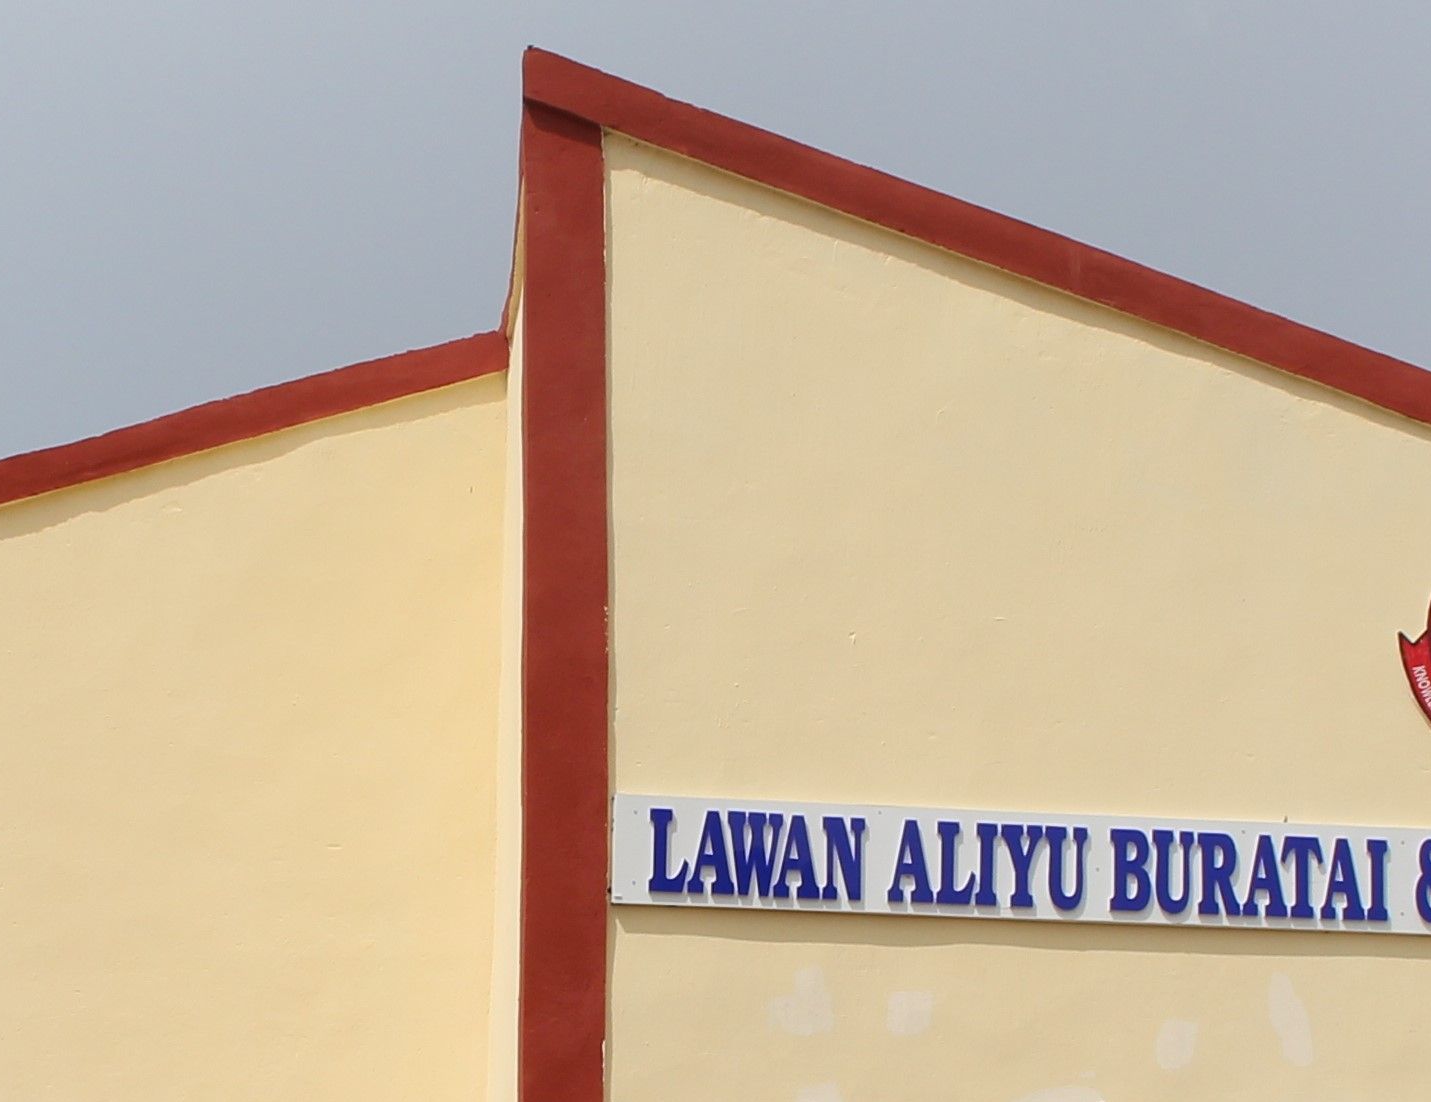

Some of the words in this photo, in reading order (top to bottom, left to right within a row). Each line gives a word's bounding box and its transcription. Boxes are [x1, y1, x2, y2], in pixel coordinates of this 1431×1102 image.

[647, 808, 866, 902] LAWAN
[886, 819, 1089, 912] ALIYU
[1108, 828, 1389, 922] BURATAI
